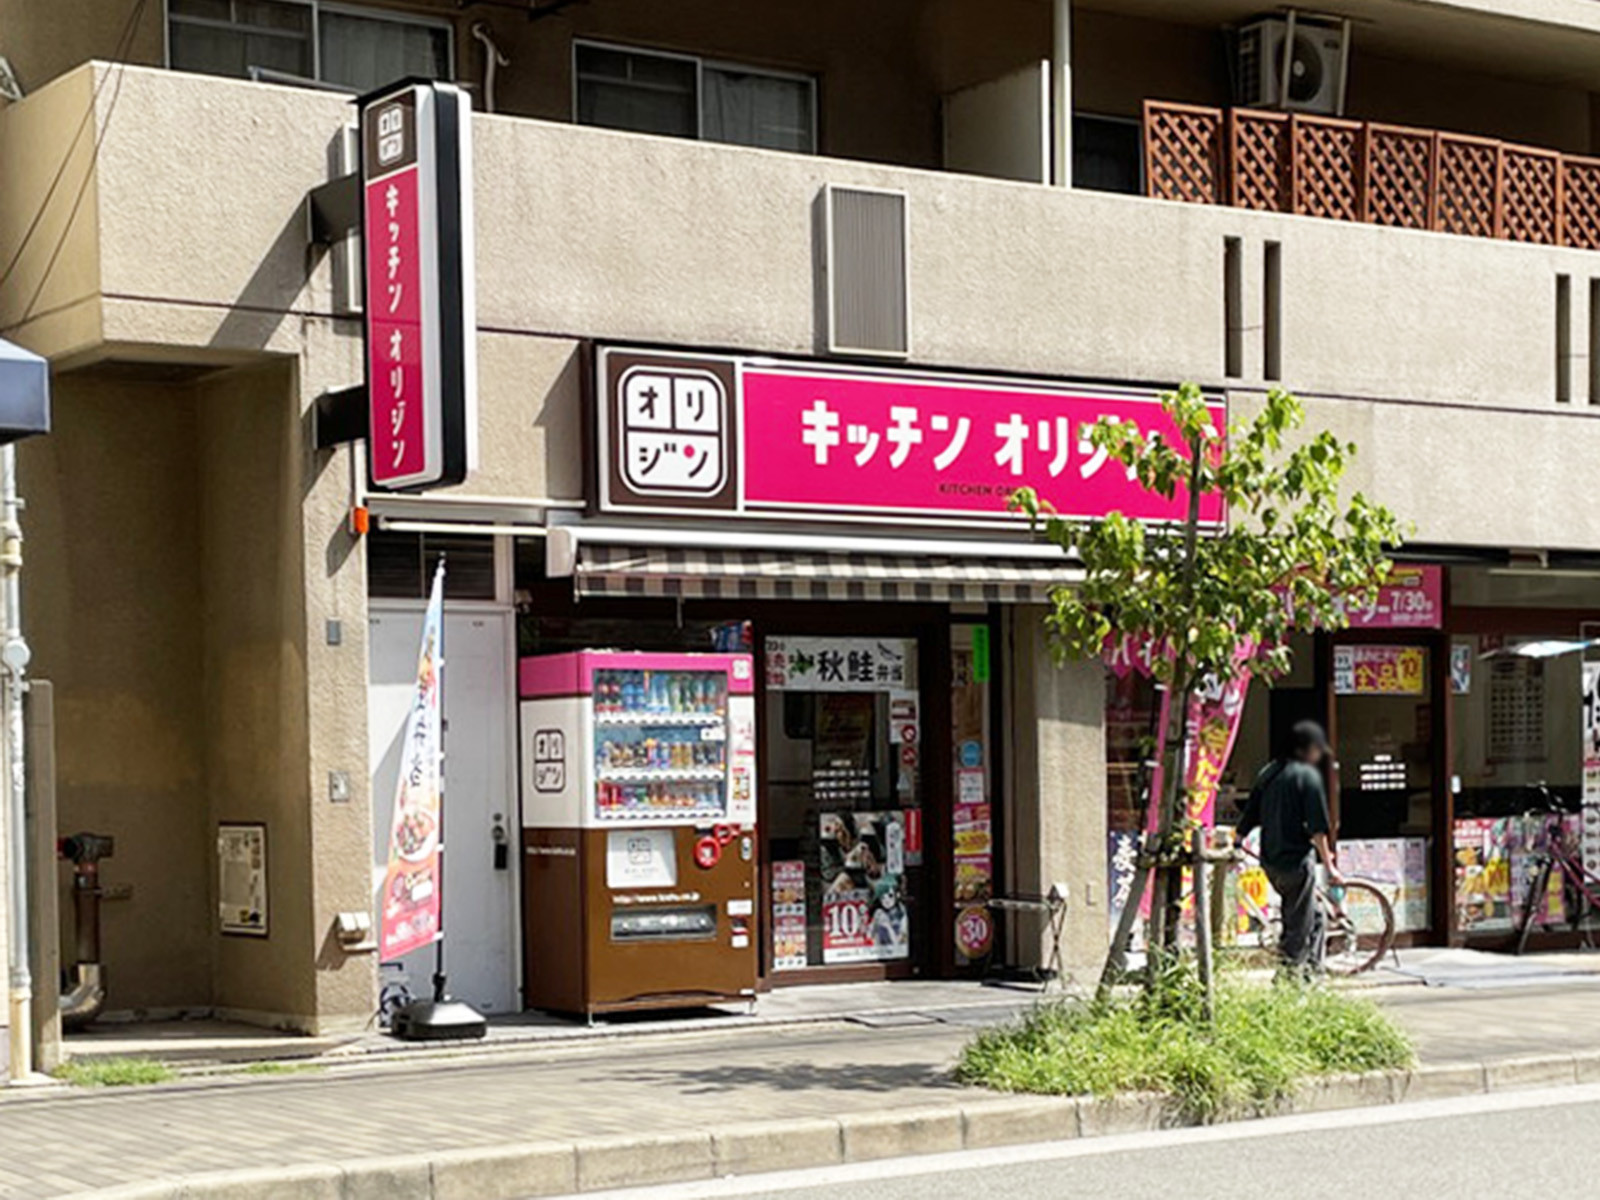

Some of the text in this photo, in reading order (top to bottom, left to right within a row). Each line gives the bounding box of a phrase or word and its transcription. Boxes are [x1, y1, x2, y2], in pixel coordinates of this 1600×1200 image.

[386, 184, 406, 469] キッチン オリジン
[802, 399, 971, 471] キッチン
